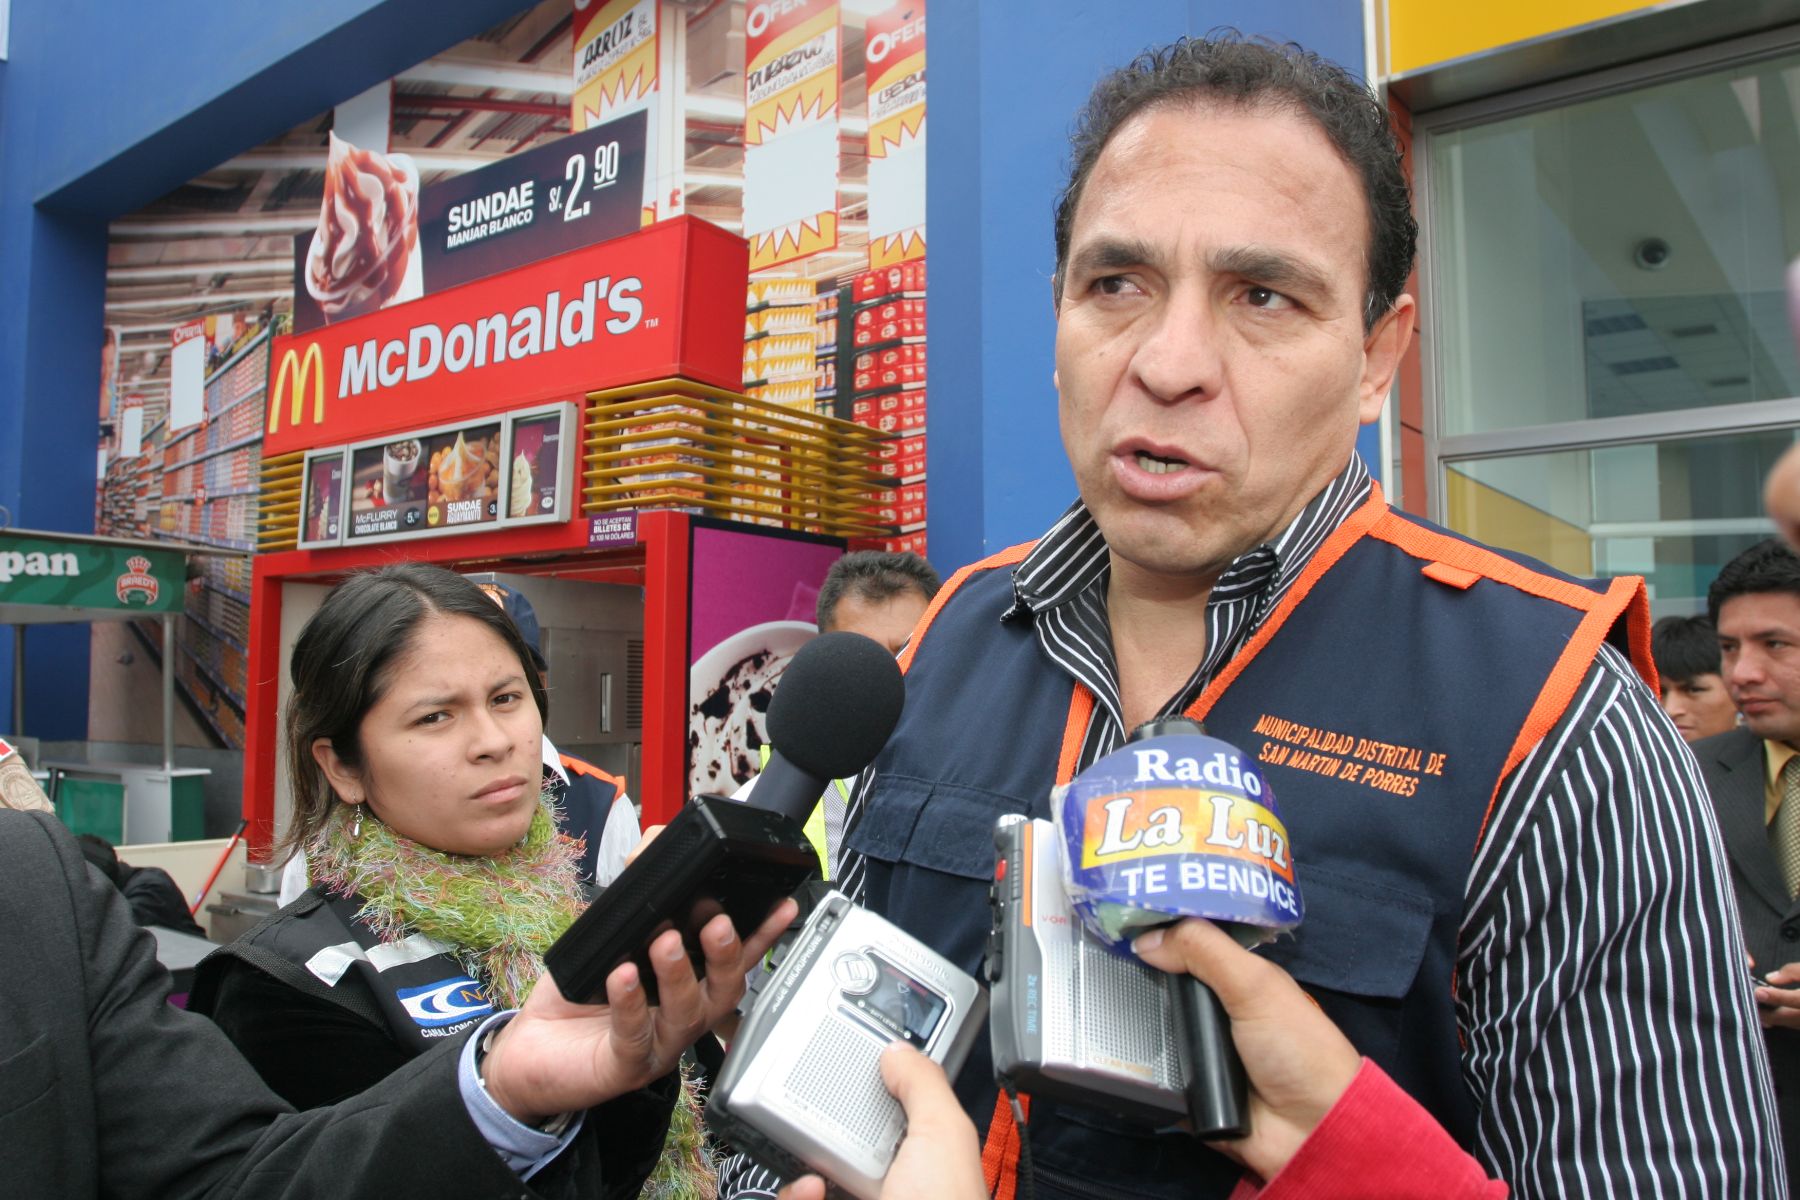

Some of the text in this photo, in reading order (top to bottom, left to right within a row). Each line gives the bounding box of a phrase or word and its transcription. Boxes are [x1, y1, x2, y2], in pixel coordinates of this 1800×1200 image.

[447, 209, 534, 248] MANJAR BLANCO
[448, 180, 535, 233] SUNDAE
[337, 276, 643, 399] McDonald's
[355, 509, 398, 524] McFLURRY
[447, 499, 481, 512] SUNDAE
[594, 523, 631, 533] BILLETES DE
[609, 516, 632, 524] ACEPTAN
[1253, 714, 1447, 776] MUNICIPALIDAD DISTRITAL DE
[1259, 742, 1420, 797] SAN MARTIN DE PORRES
[1133, 749, 1262, 797] Radio
[1095, 796, 1288, 870] La Luz
[1120, 861, 1299, 917] TE BENDICE
